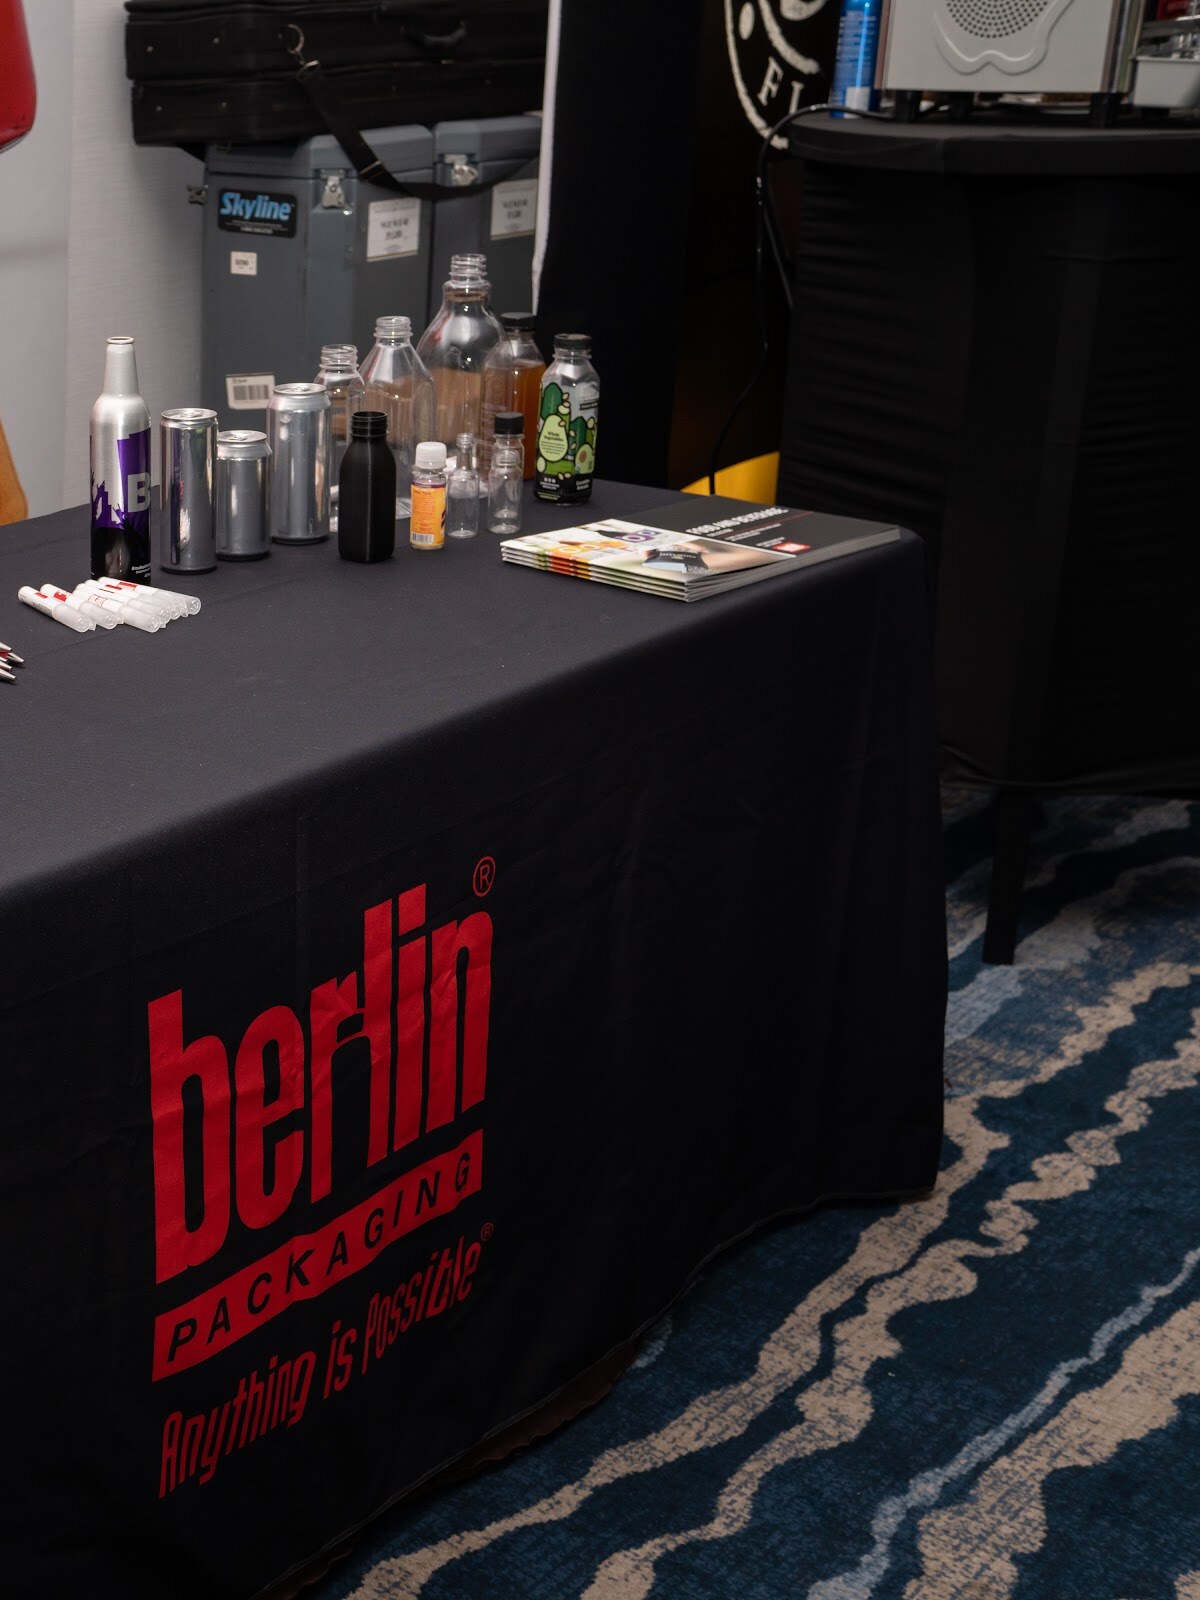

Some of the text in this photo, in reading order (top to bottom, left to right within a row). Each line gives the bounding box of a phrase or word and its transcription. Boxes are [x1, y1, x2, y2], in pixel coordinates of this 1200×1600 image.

[220, 192, 291, 221] Skyline
[147, 883, 495, 1284] berlin
[168, 1150, 472, 1362] PACKAGING
[159, 1349, 316, 1499] Anything
[324, 1320, 354, 1402] is
